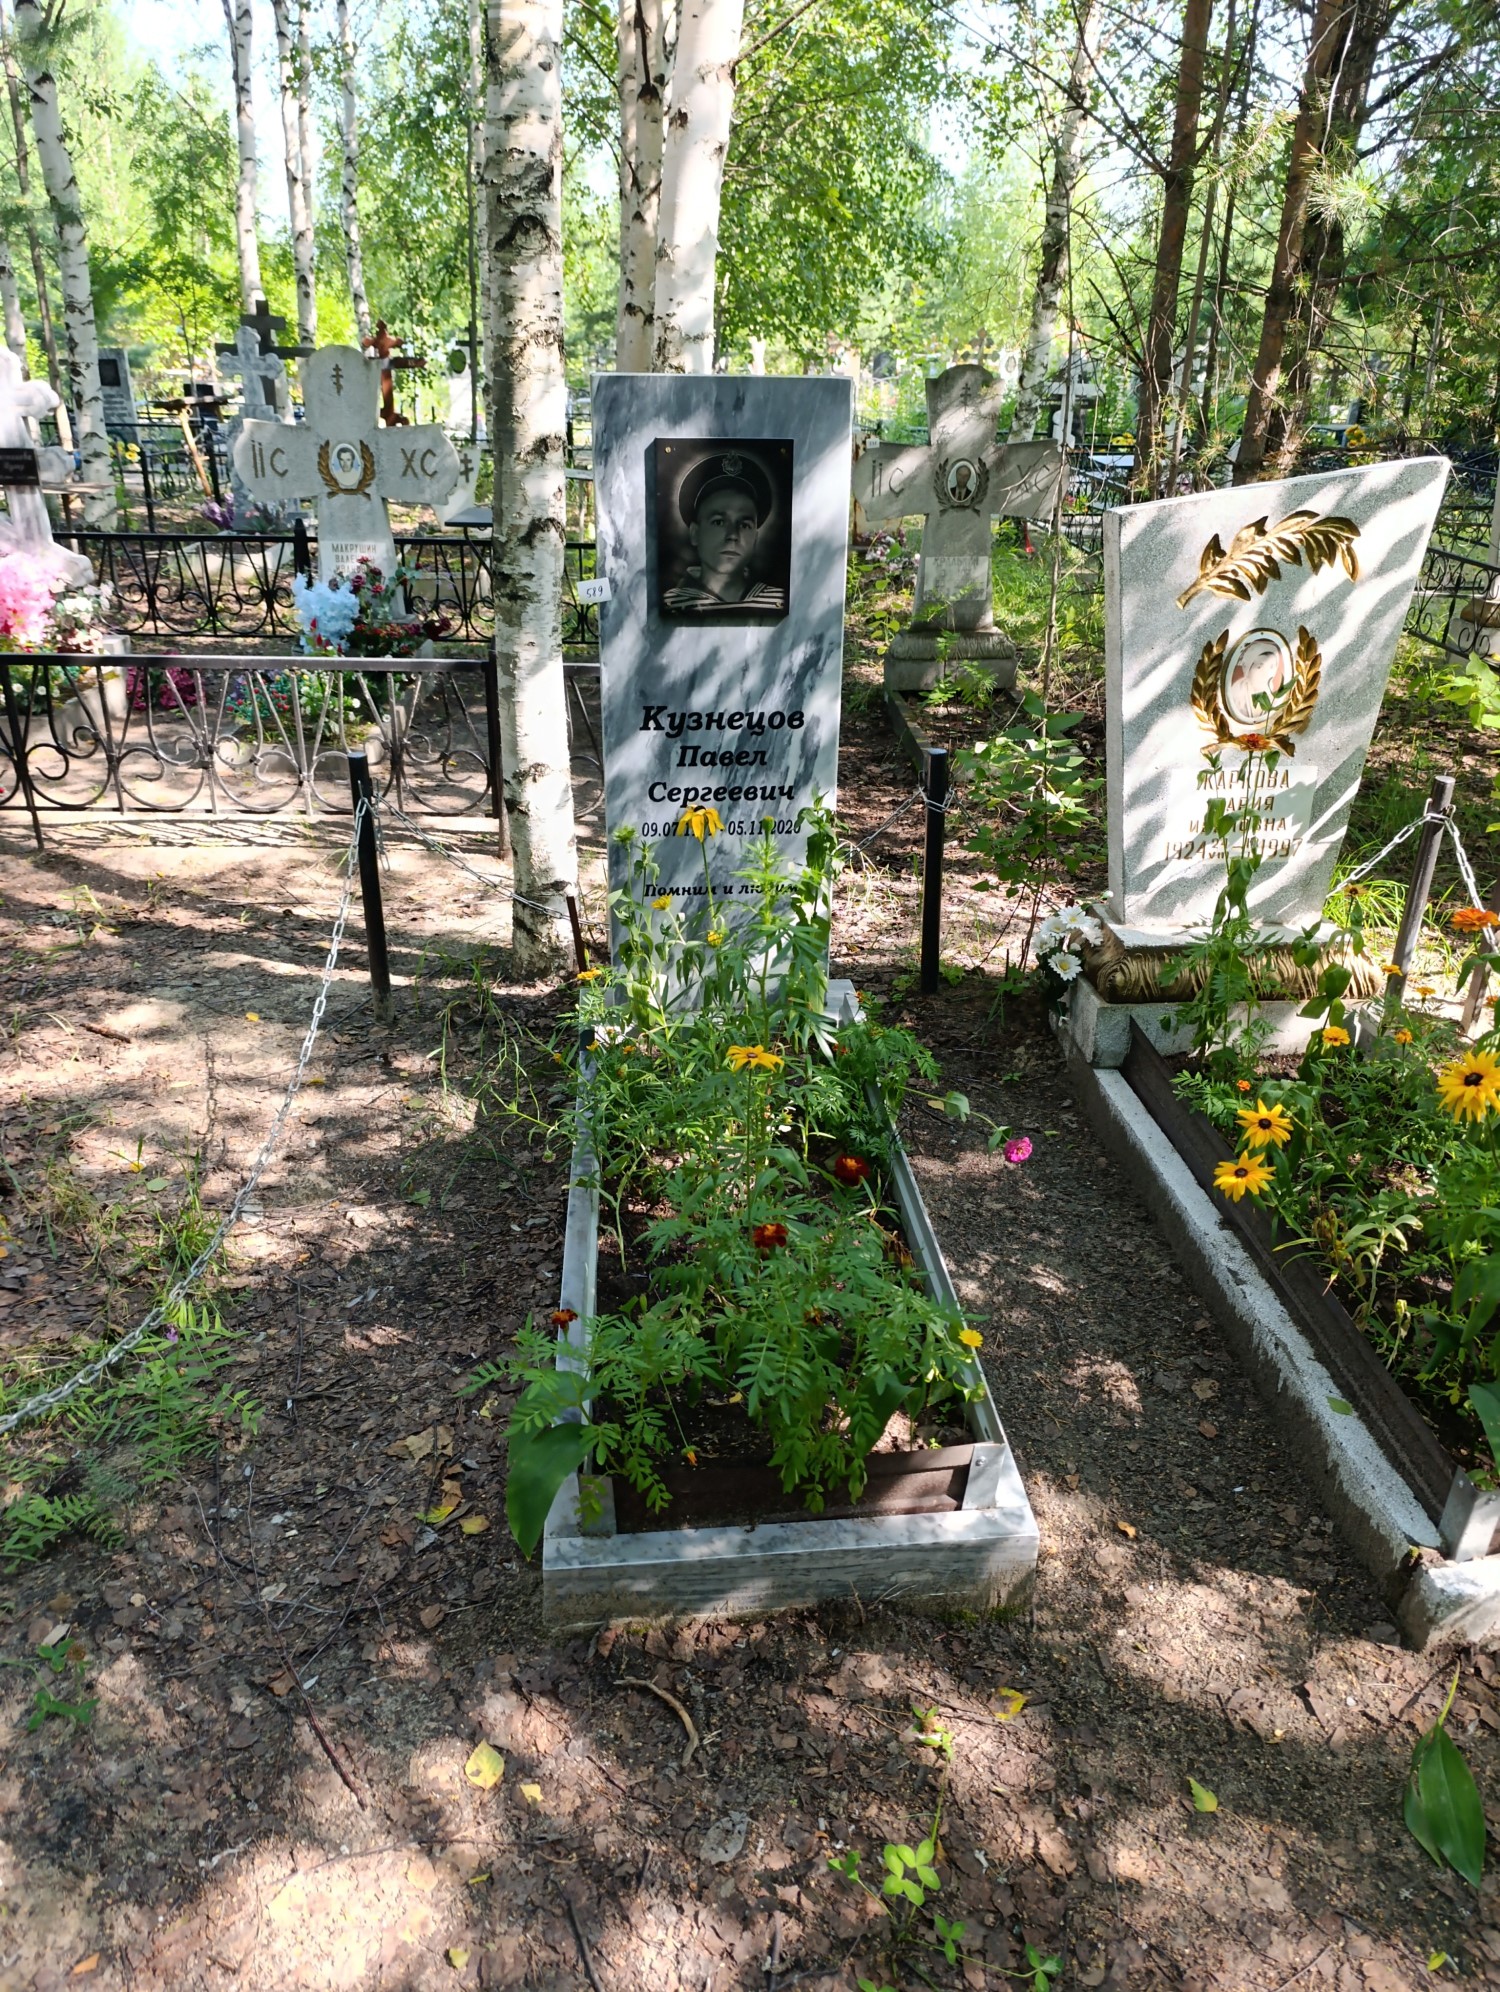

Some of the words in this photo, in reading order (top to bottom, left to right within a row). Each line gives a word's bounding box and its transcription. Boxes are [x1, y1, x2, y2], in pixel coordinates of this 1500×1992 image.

[400, 447, 438, 479] ХС
[639, 705, 805, 738] Кузнецов
[676, 745, 768, 767] Павел
[648, 781, 795, 808] Сергеевич
[1212, 796, 1275, 811] АРИЯ
[644, 884, 717, 897] Помним
[723, 885, 734, 895] и
[738, 883, 800, 895] люим
